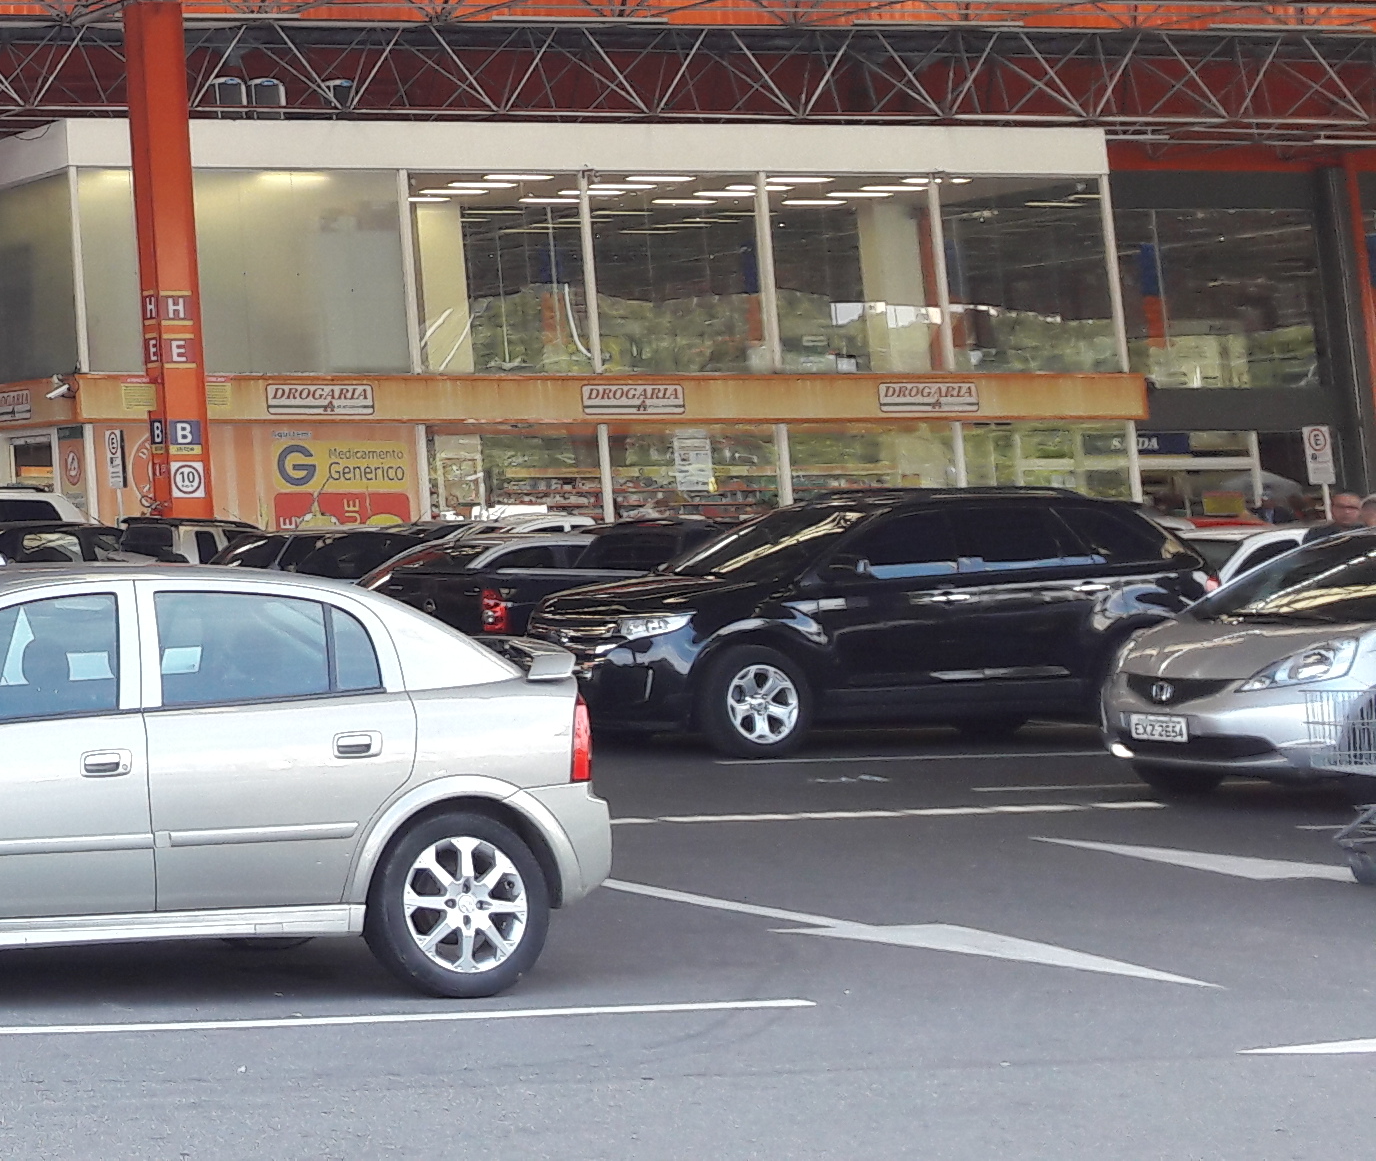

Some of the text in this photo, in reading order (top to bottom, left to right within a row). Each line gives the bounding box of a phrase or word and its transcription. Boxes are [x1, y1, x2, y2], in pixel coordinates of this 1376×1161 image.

[146, 297, 155, 318] H
[167, 297, 185, 318] H
[149, 340, 157, 360] E
[171, 340, 187, 361] E
[271, 388, 368, 400] DROGARIA
[588, 387, 680, 400] DROGARIA
[884, 385, 973, 398] DROGARIA
[176, 422, 192, 444] B
[328, 447, 404, 460] Medicamento
[1110, 437, 1159, 450] SDA
[277, 444, 317, 487] G
[328, 461, 405, 481] Genérico
[179, 471, 196, 484] 10
